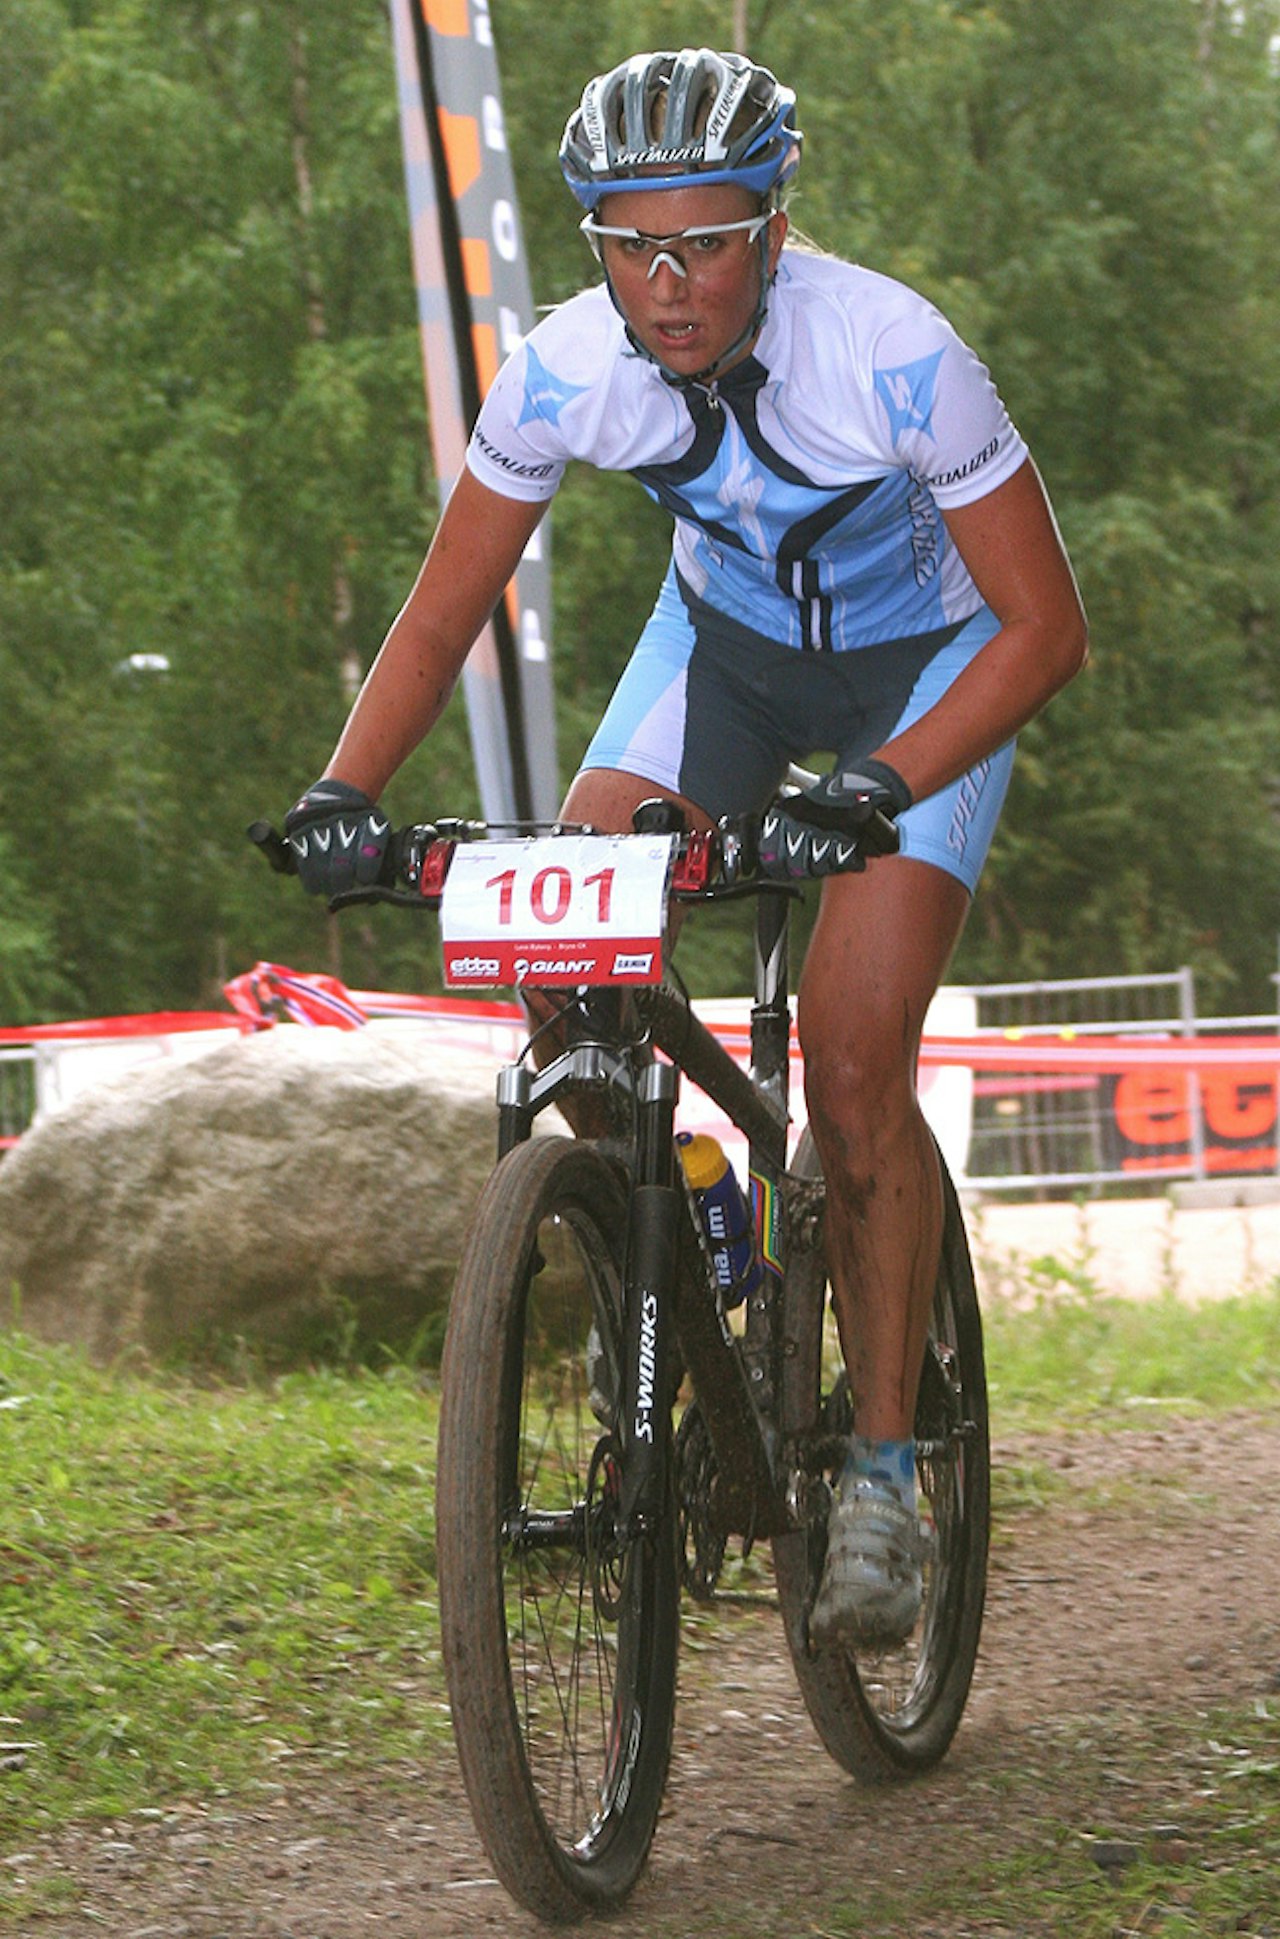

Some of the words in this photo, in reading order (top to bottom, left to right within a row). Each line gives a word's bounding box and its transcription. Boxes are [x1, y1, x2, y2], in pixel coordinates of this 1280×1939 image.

[485, 866, 615, 925] 101
[530, 958, 596, 974] GIANT
[635, 1290, 658, 1444] S-WORKS
